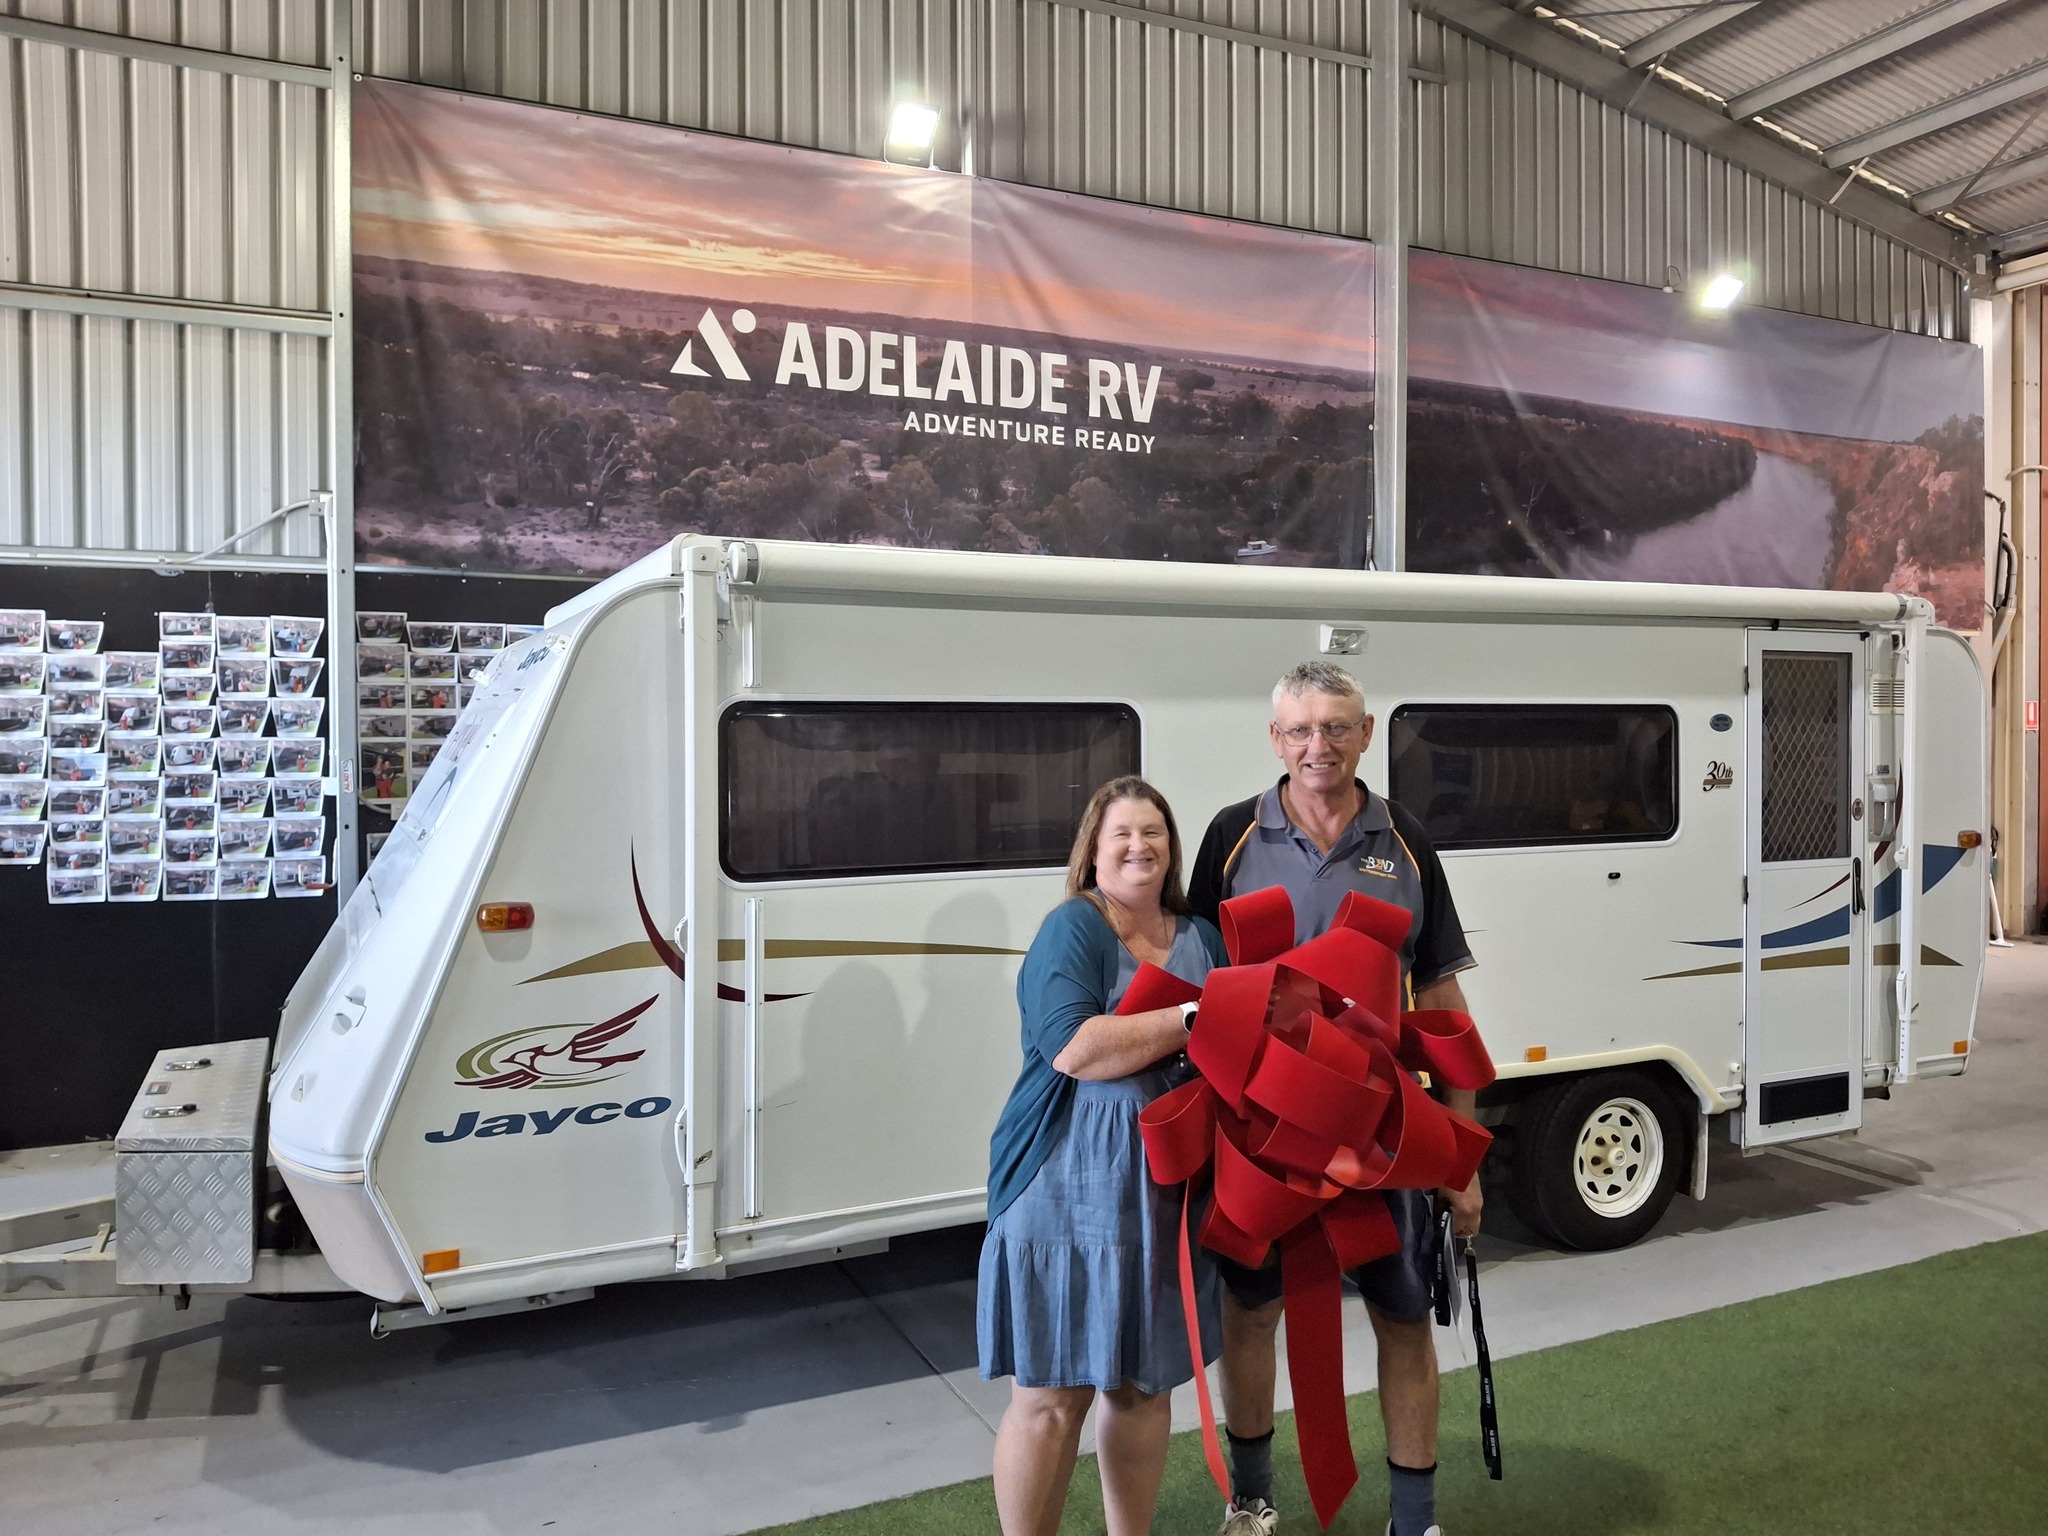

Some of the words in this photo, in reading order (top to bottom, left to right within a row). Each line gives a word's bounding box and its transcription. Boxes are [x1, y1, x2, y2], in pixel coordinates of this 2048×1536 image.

[775, 321, 1068, 414] ADELAIDE
[1088, 358, 1162, 424] RV
[904, 411, 1065, 446] ADVENTURE
[1075, 429, 1156, 454] READY
[424, 1096, 672, 1143] Jayco
